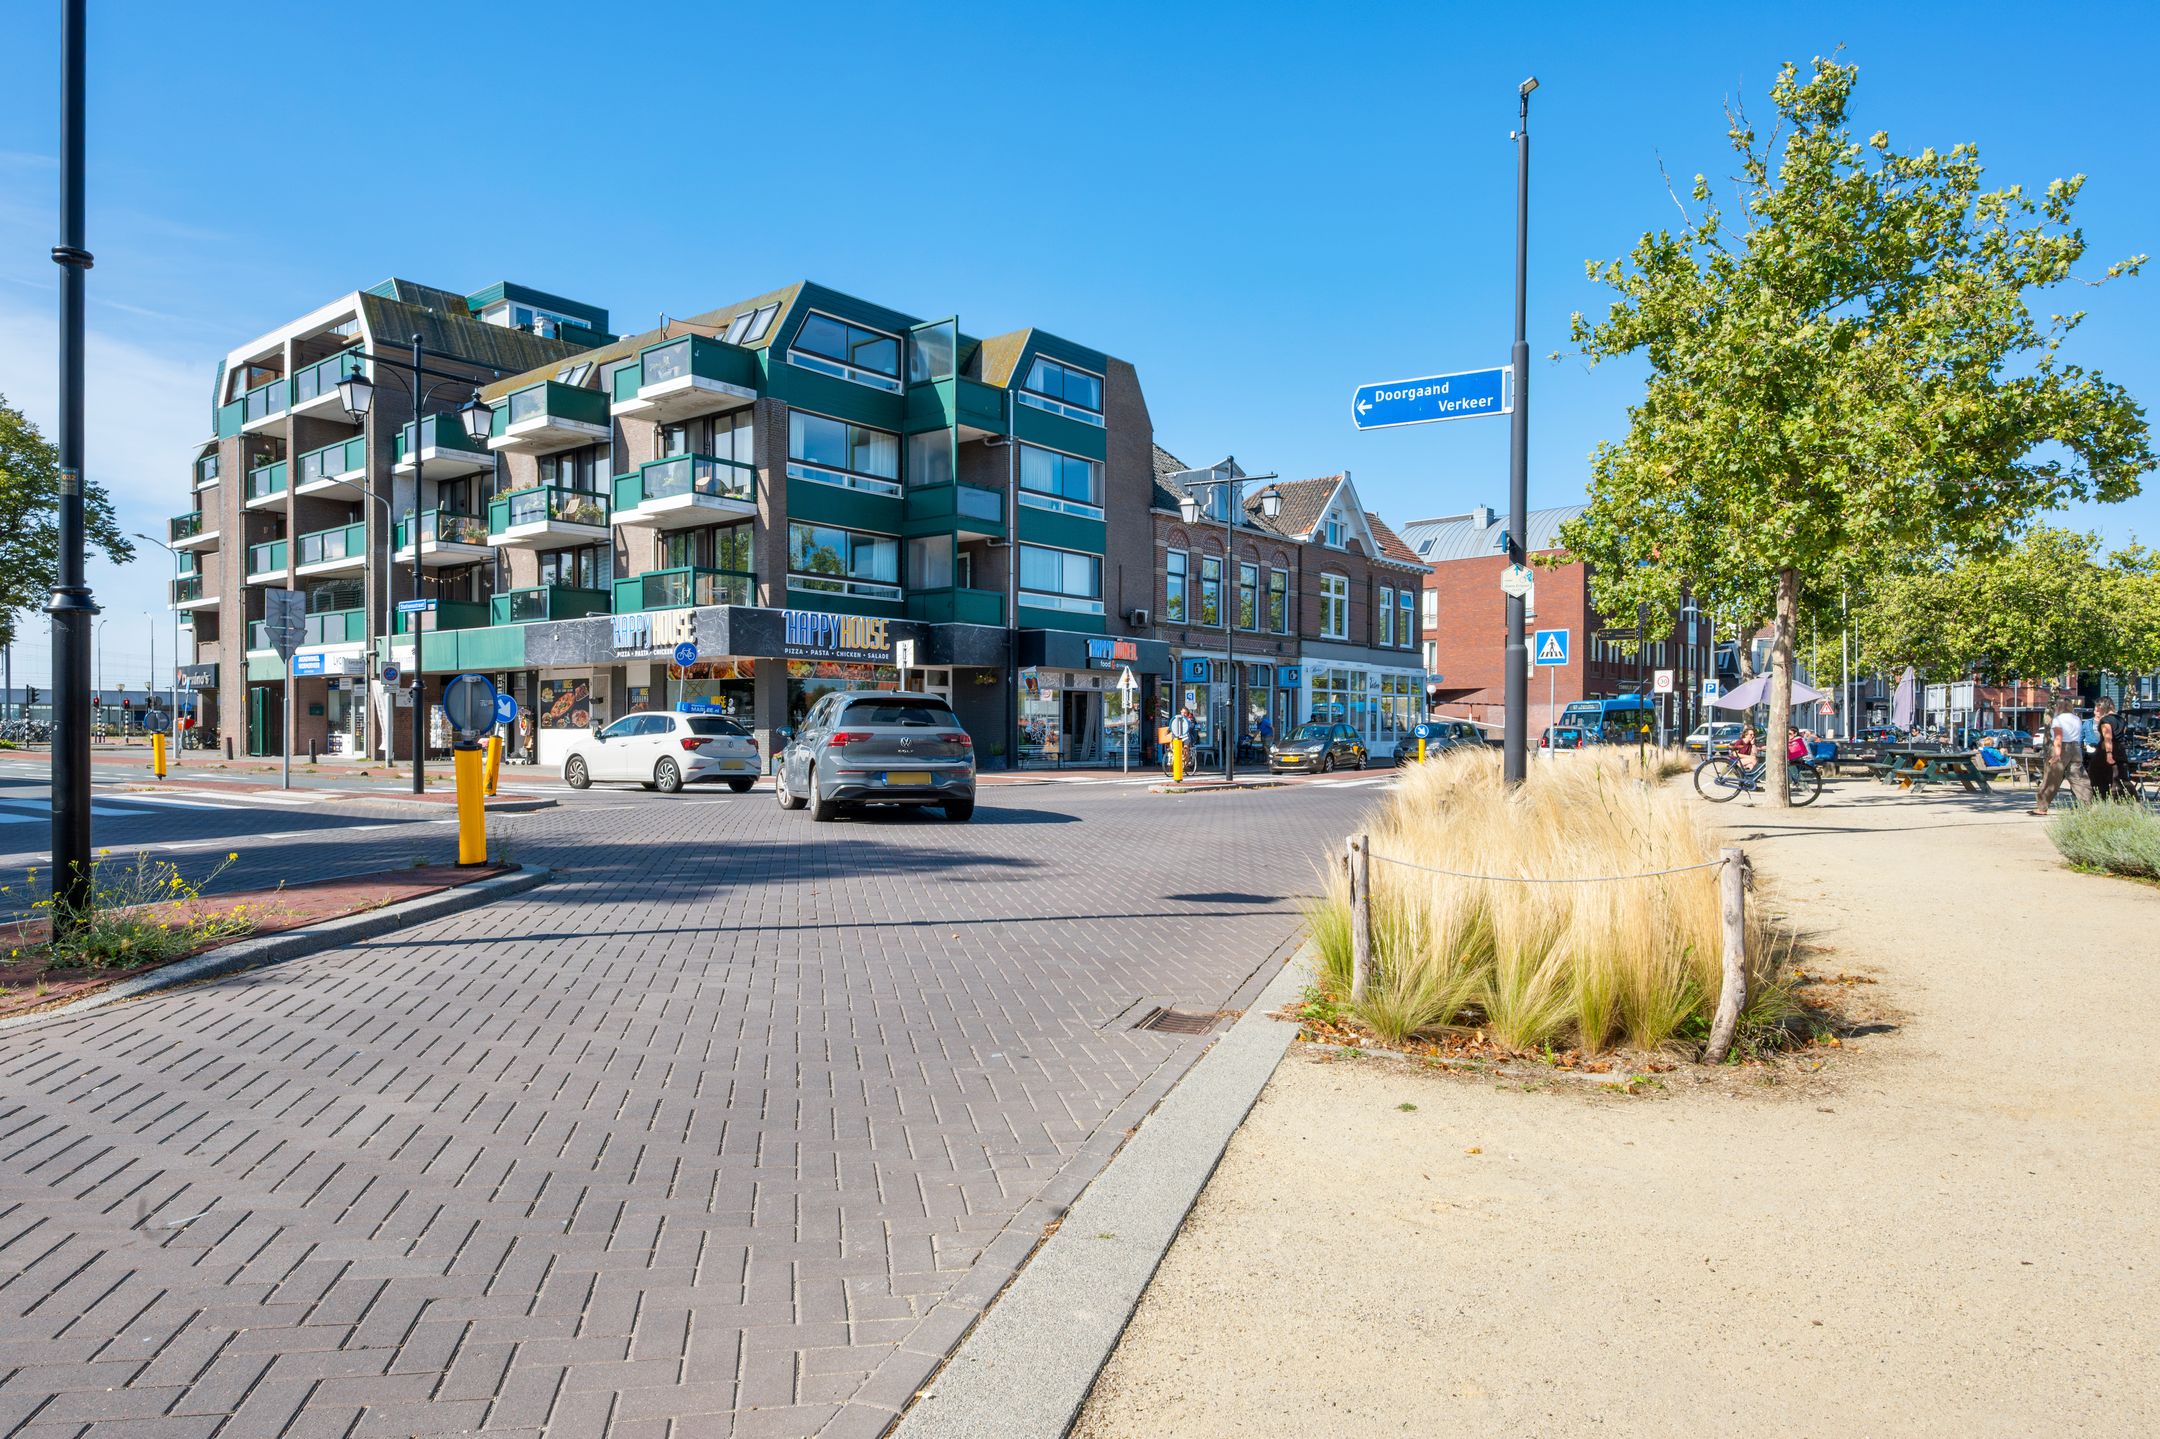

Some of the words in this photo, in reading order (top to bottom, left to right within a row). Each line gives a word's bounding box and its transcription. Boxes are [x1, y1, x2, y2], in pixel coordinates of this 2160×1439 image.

[1375, 382, 1449, 402] Doorgaand
[1438, 396, 1494, 412] Verkeer
[1707, 684, 1715, 693] P
